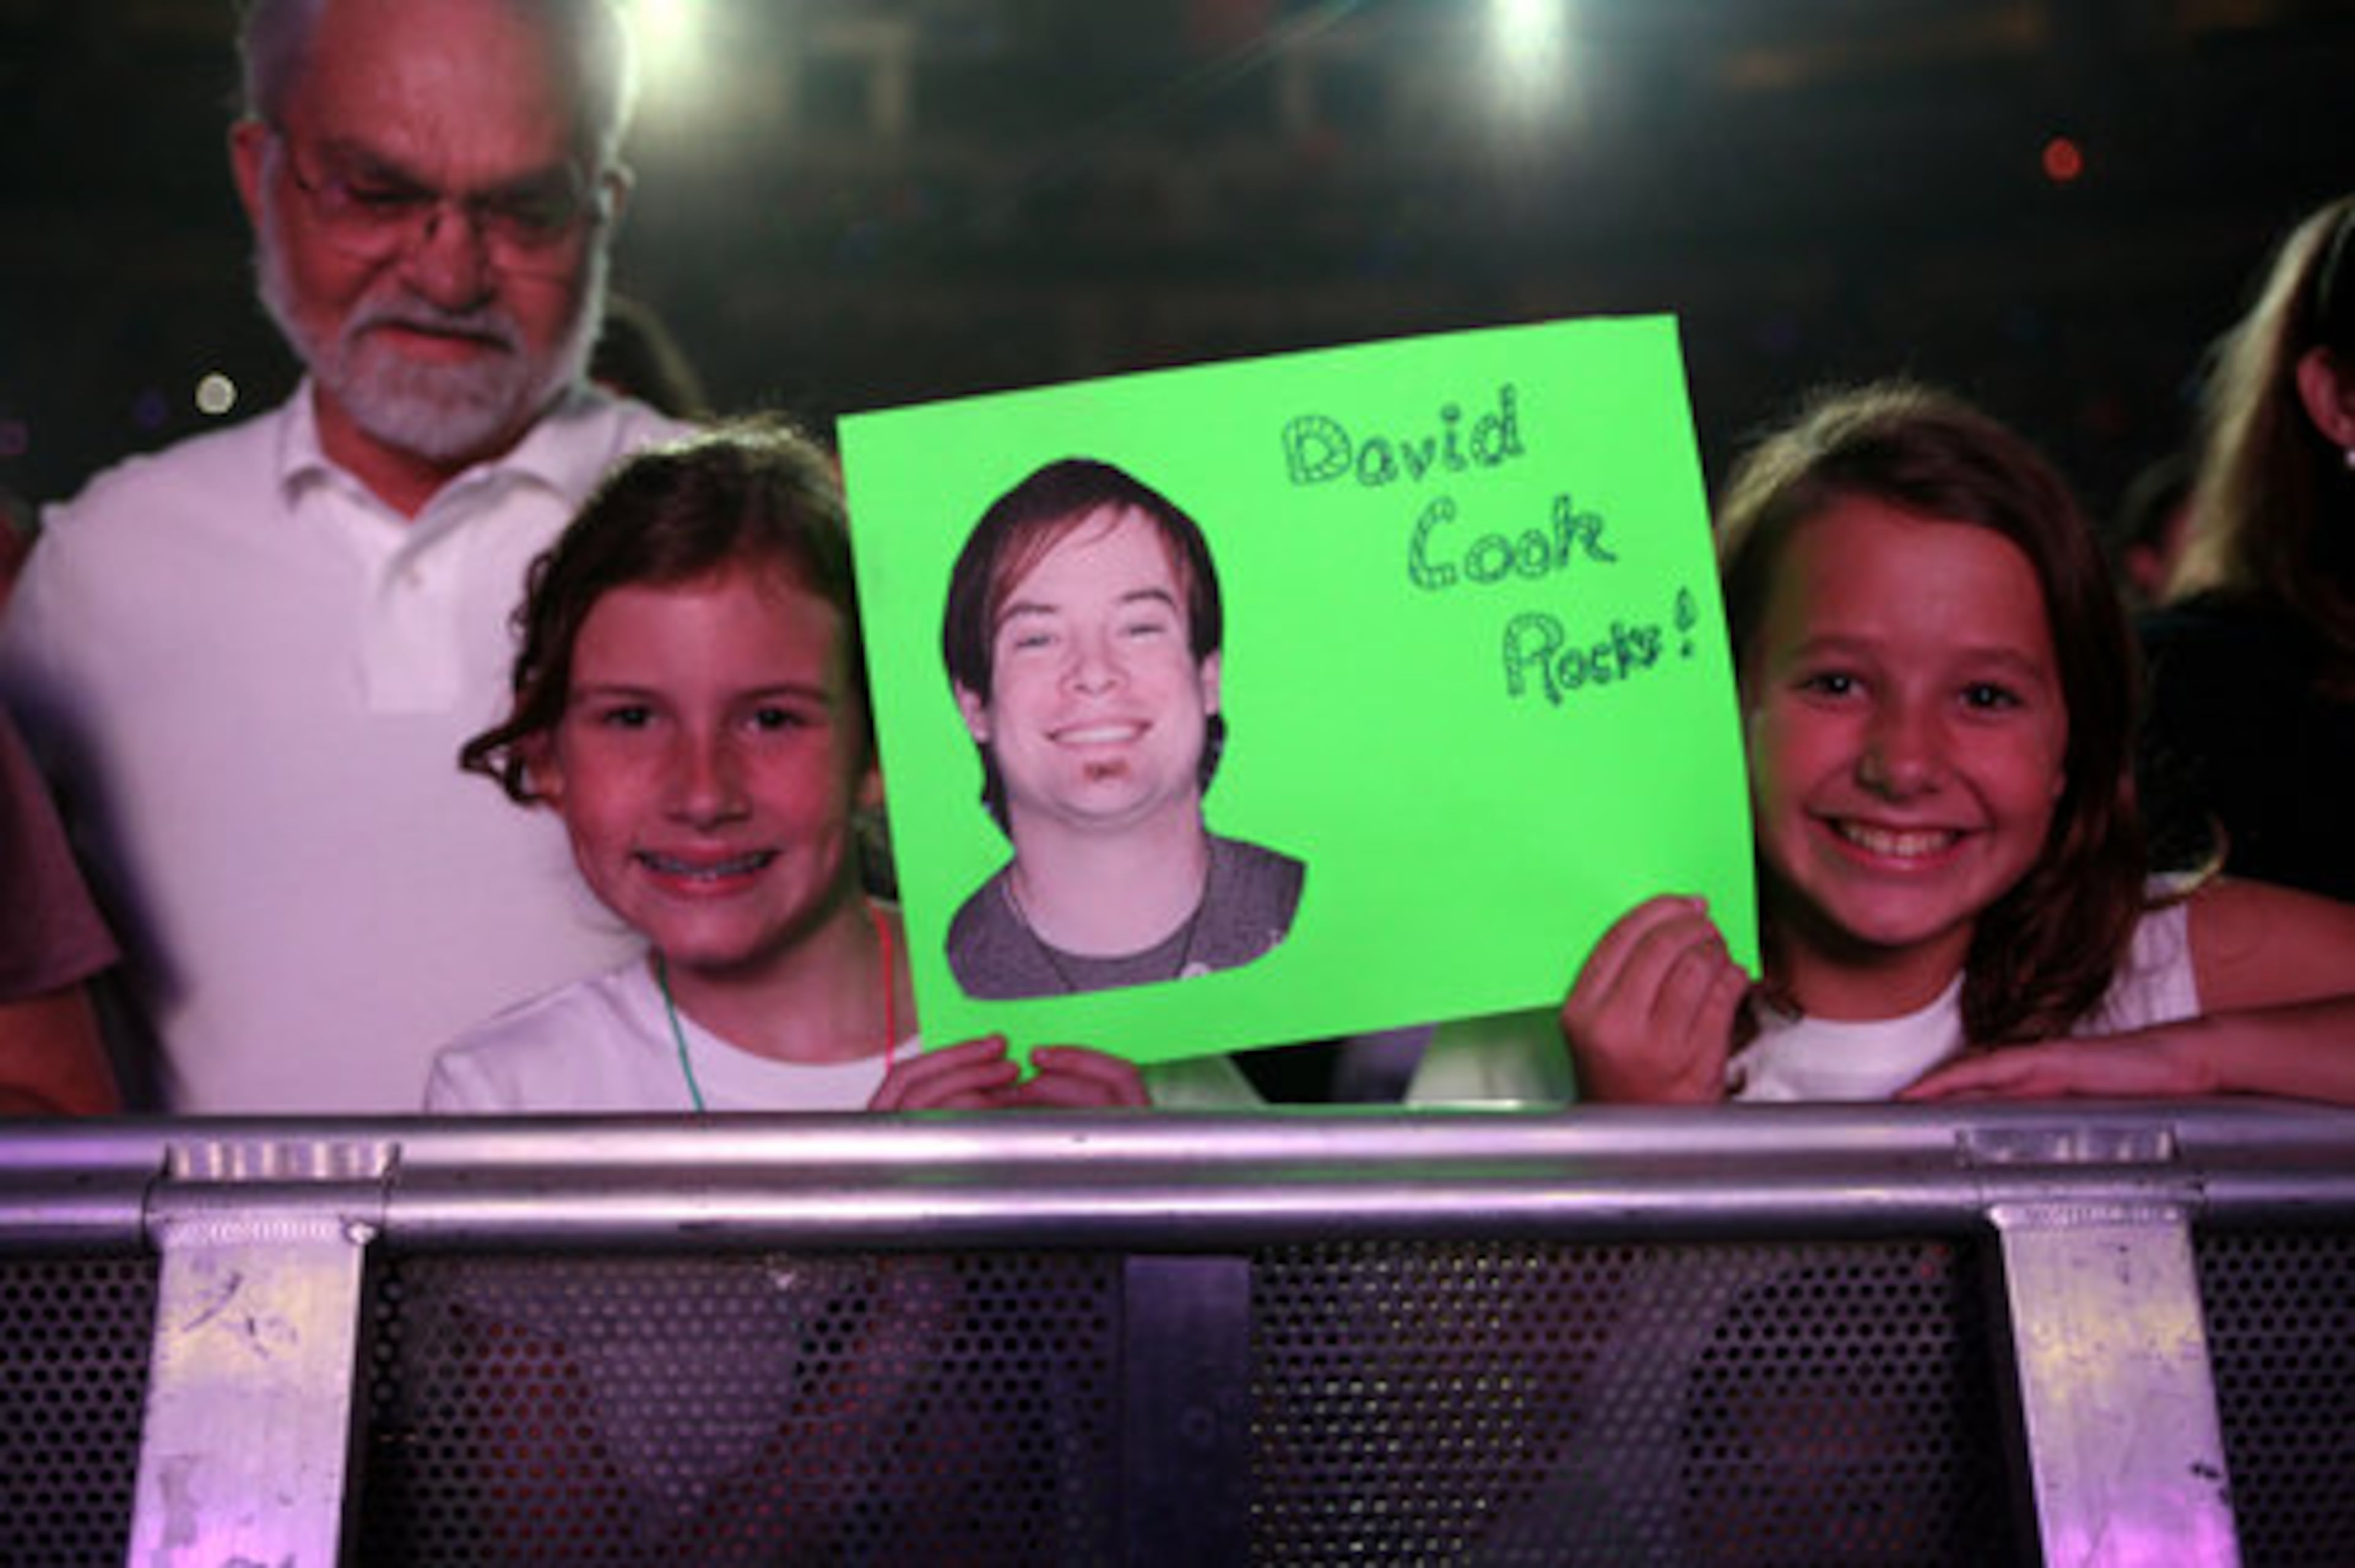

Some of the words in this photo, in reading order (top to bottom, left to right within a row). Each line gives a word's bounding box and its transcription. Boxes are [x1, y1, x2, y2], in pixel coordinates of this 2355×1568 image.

[1282, 383, 1525, 486] David
[1407, 494, 1618, 590] Cook
[1503, 587, 1696, 707] Rocks!
